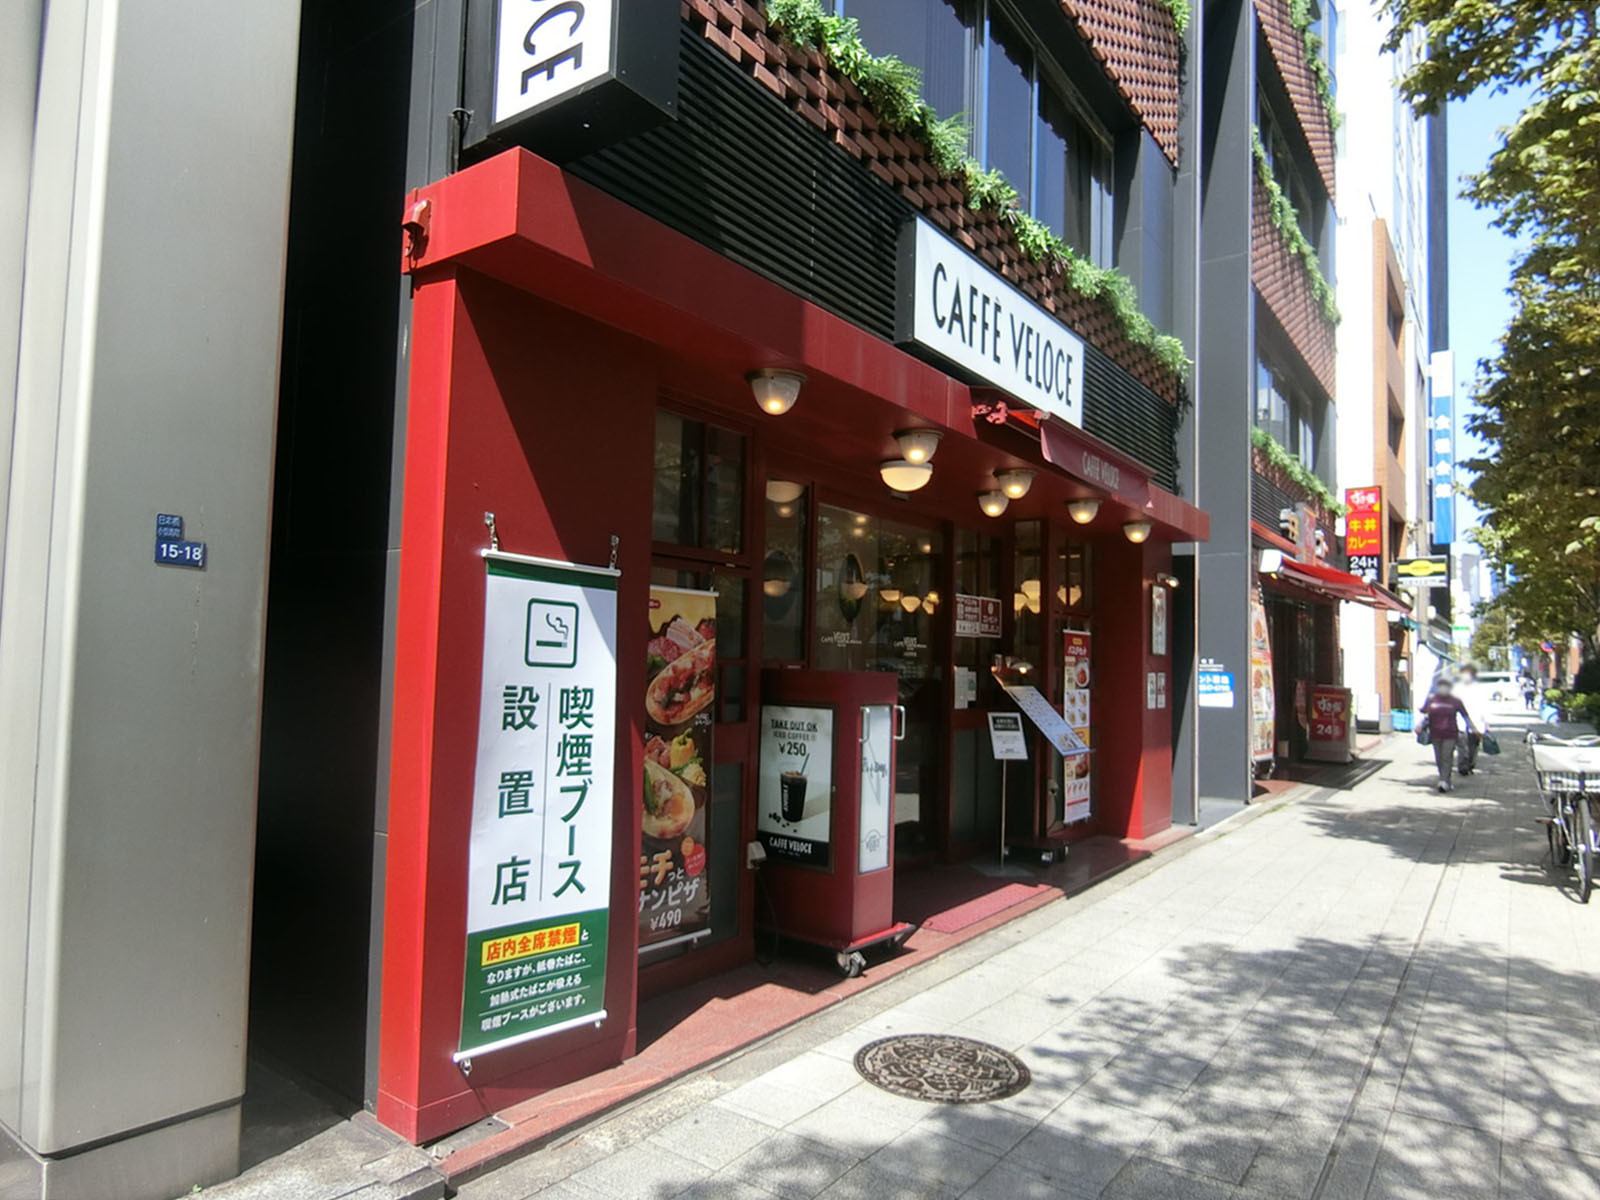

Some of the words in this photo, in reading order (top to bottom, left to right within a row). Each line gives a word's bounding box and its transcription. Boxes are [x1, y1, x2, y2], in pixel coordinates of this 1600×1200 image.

[521, 0, 585, 95] CE
[932, 262, 1002, 365] CAFFÈ
[1010, 312, 1074, 407] VELOCE
[1348, 518, 1377, 532] 牛丼
[161, 544, 202, 560] 15-18
[1348, 536, 1378, 549] カレー
[1350, 556, 1378, 569] 24H
[771, 719, 788, 730] TAKE
[790, 720, 805, 731] OUT
[806, 721, 818, 732] OK
[491, 684, 540, 905] 設置店
[552, 686, 594, 898] 喫煙ブース
[650, 908, 682, 930] ¥490
